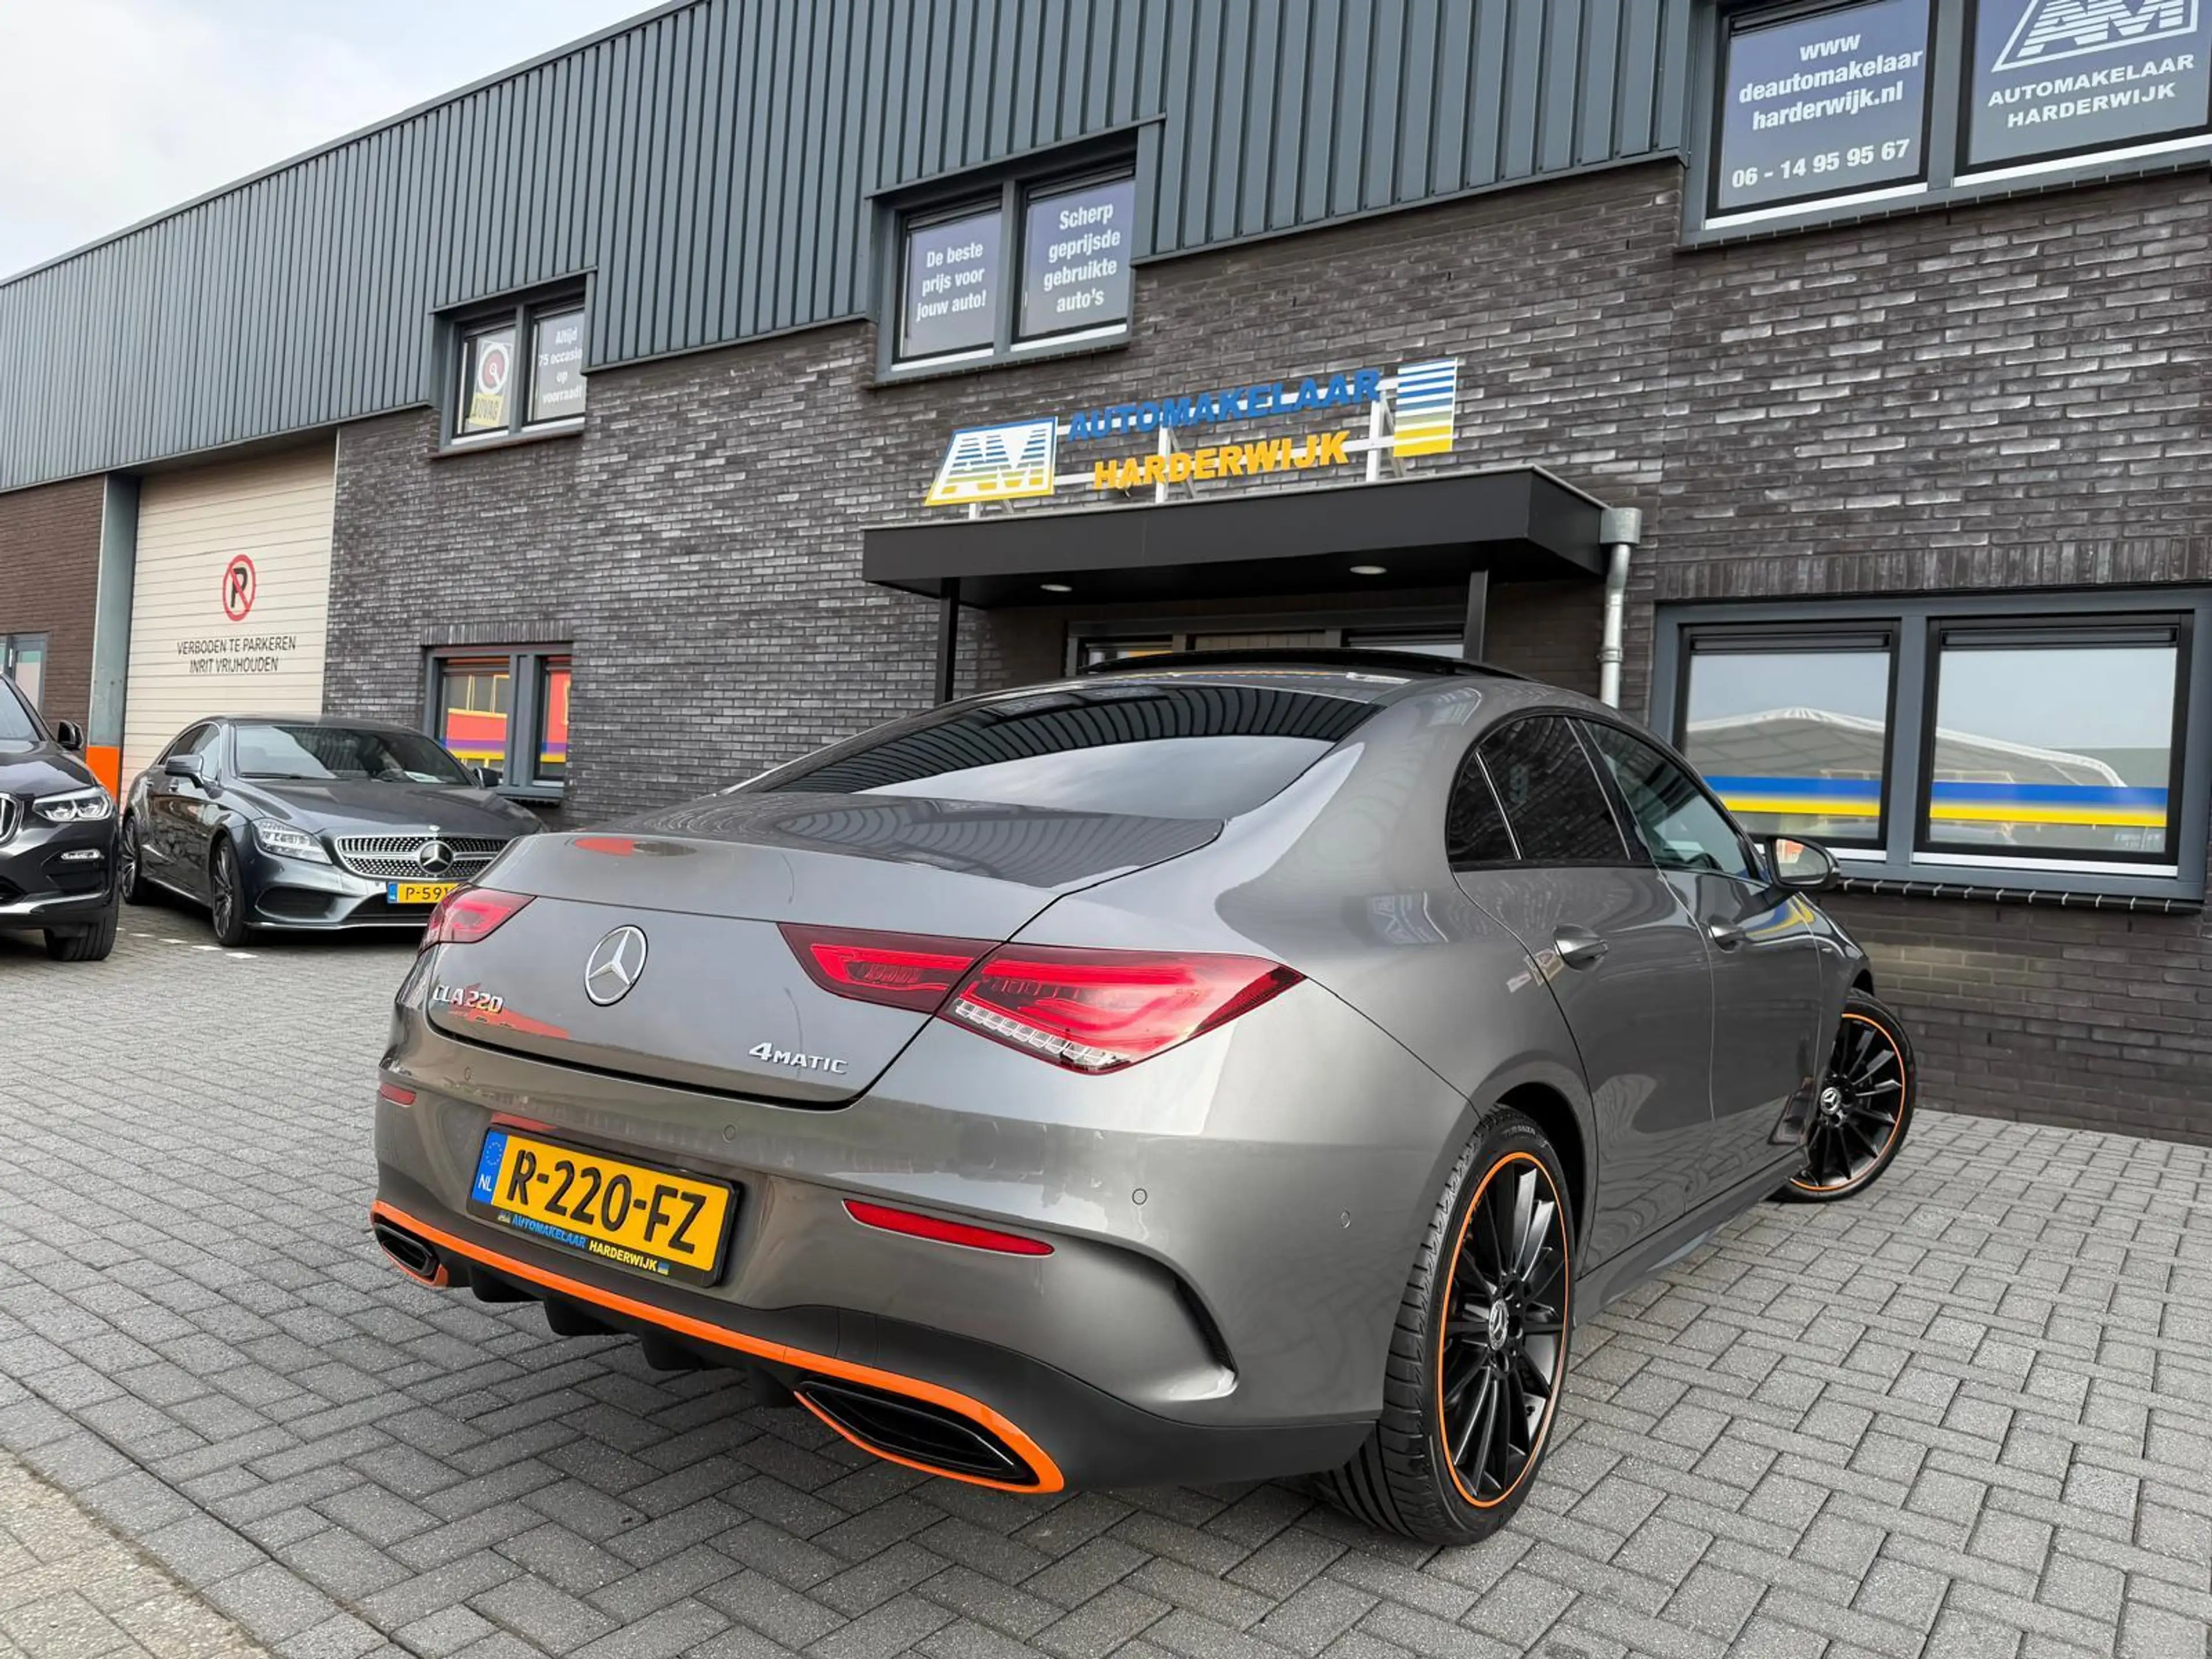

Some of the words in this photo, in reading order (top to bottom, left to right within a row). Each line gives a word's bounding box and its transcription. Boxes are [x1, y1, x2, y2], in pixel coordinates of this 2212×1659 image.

[1800, 33, 1861, 61] www
[1739, 50, 1923, 104] deautomakelaar
[1988, 54, 2194, 107] AUTOMAKELAAR
[1752, 80, 1903, 131] harderwijk.nl
[2007, 82, 2176, 128] HARDERWIJK
[1732, 168, 1758, 188] 06
[1781, 158, 1806, 179] 14
[1813, 151, 1840, 173] 95
[1847, 145, 1874, 167] 95
[1881, 138, 1910, 161] 67
[1060, 204, 1113, 230] Scherp
[927, 251, 943, 268] De
[947, 242, 983, 264] beste
[1049, 230, 1120, 264] geprijsde
[922, 272, 951, 296] prijs
[955, 267, 984, 286] voor
[1044, 259, 1117, 291] gebruikte
[916, 298, 949, 323] jouw
[952, 291, 986, 312] auto!
[1056, 289, 1104, 312] auto's
[1067, 368, 1382, 443] AUTOMAKELAAR
[1093, 431, 1350, 490] HARDERWIJK
[177, 639, 226, 655] VERBODEN
[230, 638, 241, 652] TE
[243, 636, 296, 652] PARKEREN
[190, 658, 213, 674] INRIT
[406, 887, 448, 900] P-591
[432, 984, 464, 1006] CLA
[464, 991, 503, 1014] 220
[748, 1041, 848, 1075] 4MATIC
[479, 1174, 493, 1194] NL
[506, 1149, 707, 1255] R-220-FZ
[512, 1214, 586, 1248] AUTOMAKELAAR
[589, 1240, 658, 1272] HARDERWIJK
